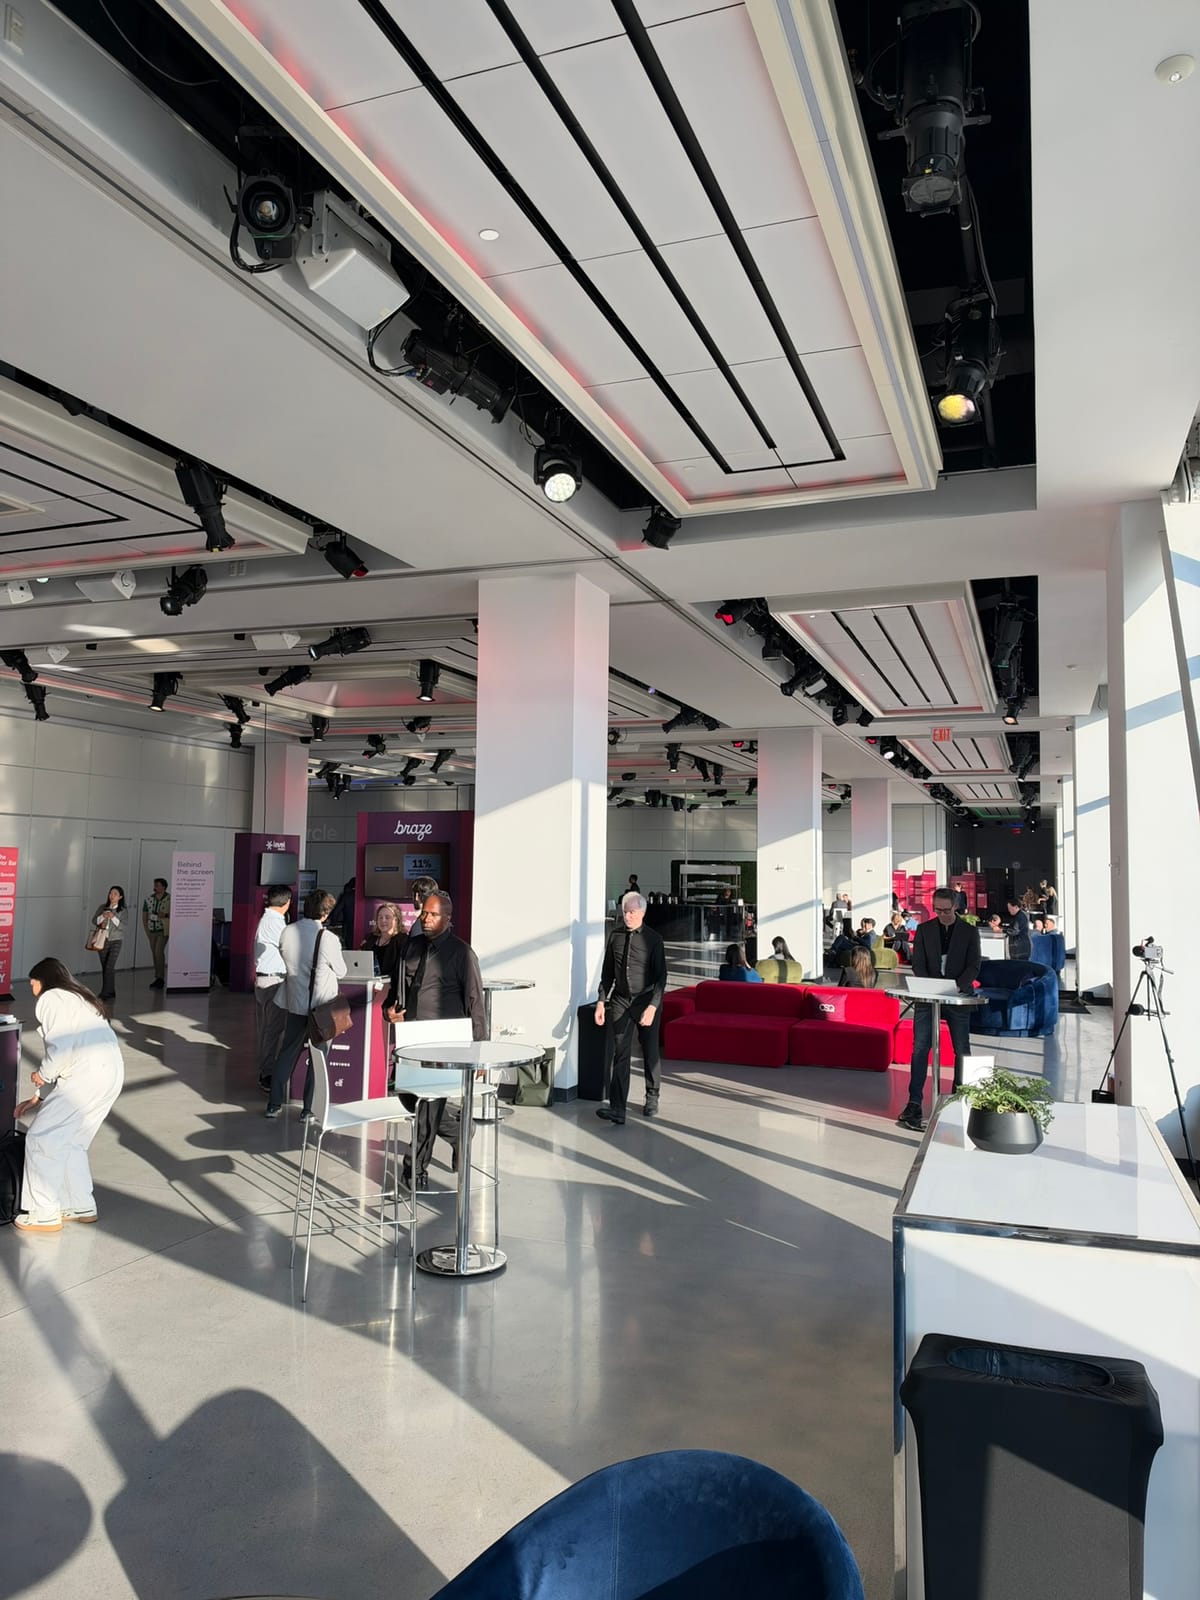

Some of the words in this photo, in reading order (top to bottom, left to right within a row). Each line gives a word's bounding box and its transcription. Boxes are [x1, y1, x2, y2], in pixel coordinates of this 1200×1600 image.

[932, 728, 950, 741] EXIT
[394, 820, 433, 841] braze
[412, 859, 432, 869] 11%
